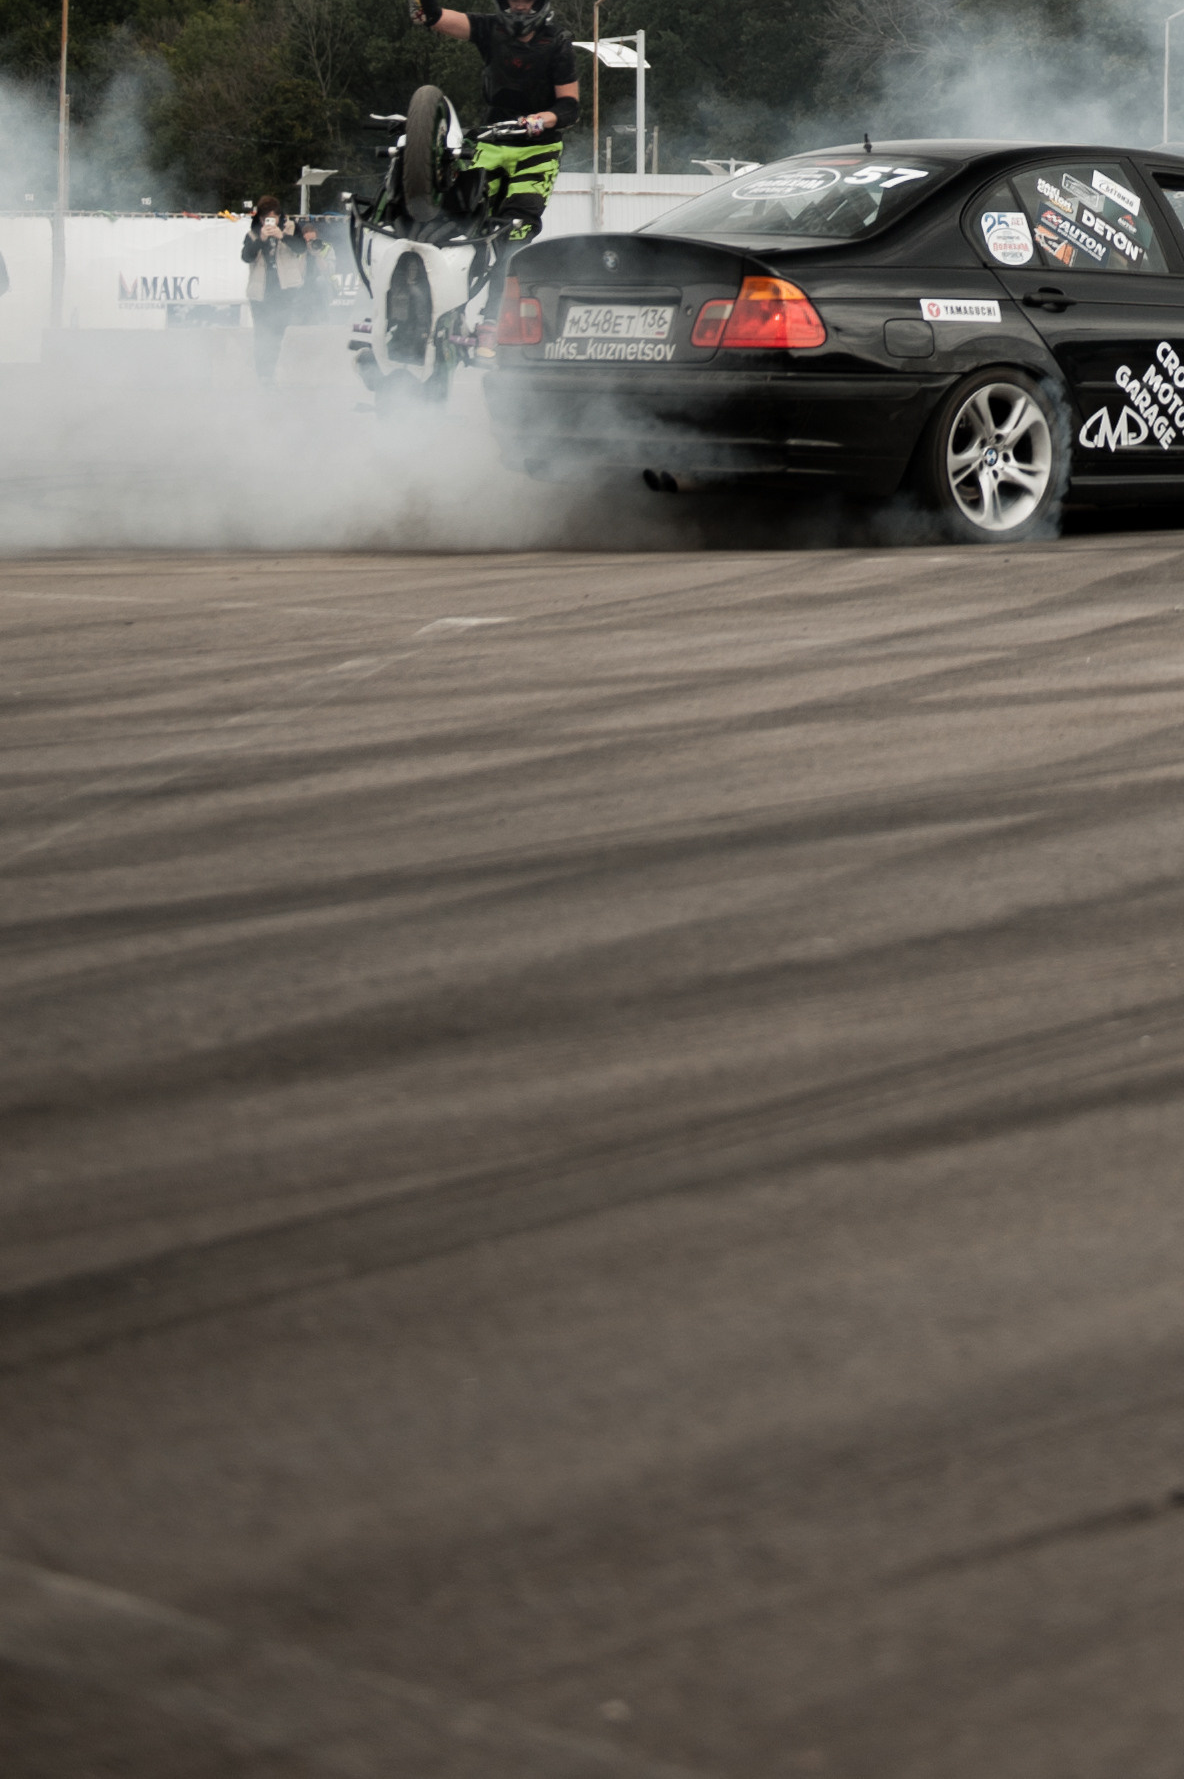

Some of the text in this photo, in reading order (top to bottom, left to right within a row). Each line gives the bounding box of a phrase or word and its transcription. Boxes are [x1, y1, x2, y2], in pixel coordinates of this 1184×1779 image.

[843, 166, 929, 189] 57
[984, 214, 1009, 233] 25
[1081, 209, 1140, 261] DETON
[1058, 221, 1107, 257] AUTON
[140, 276, 200, 300] МАКС
[641, 308, 668, 328] 136
[943, 305, 996, 317] YAMAGUCHI
[544, 337, 676, 361] niks_kuznetsov
[1115, 365, 1176, 450] GARAGE
